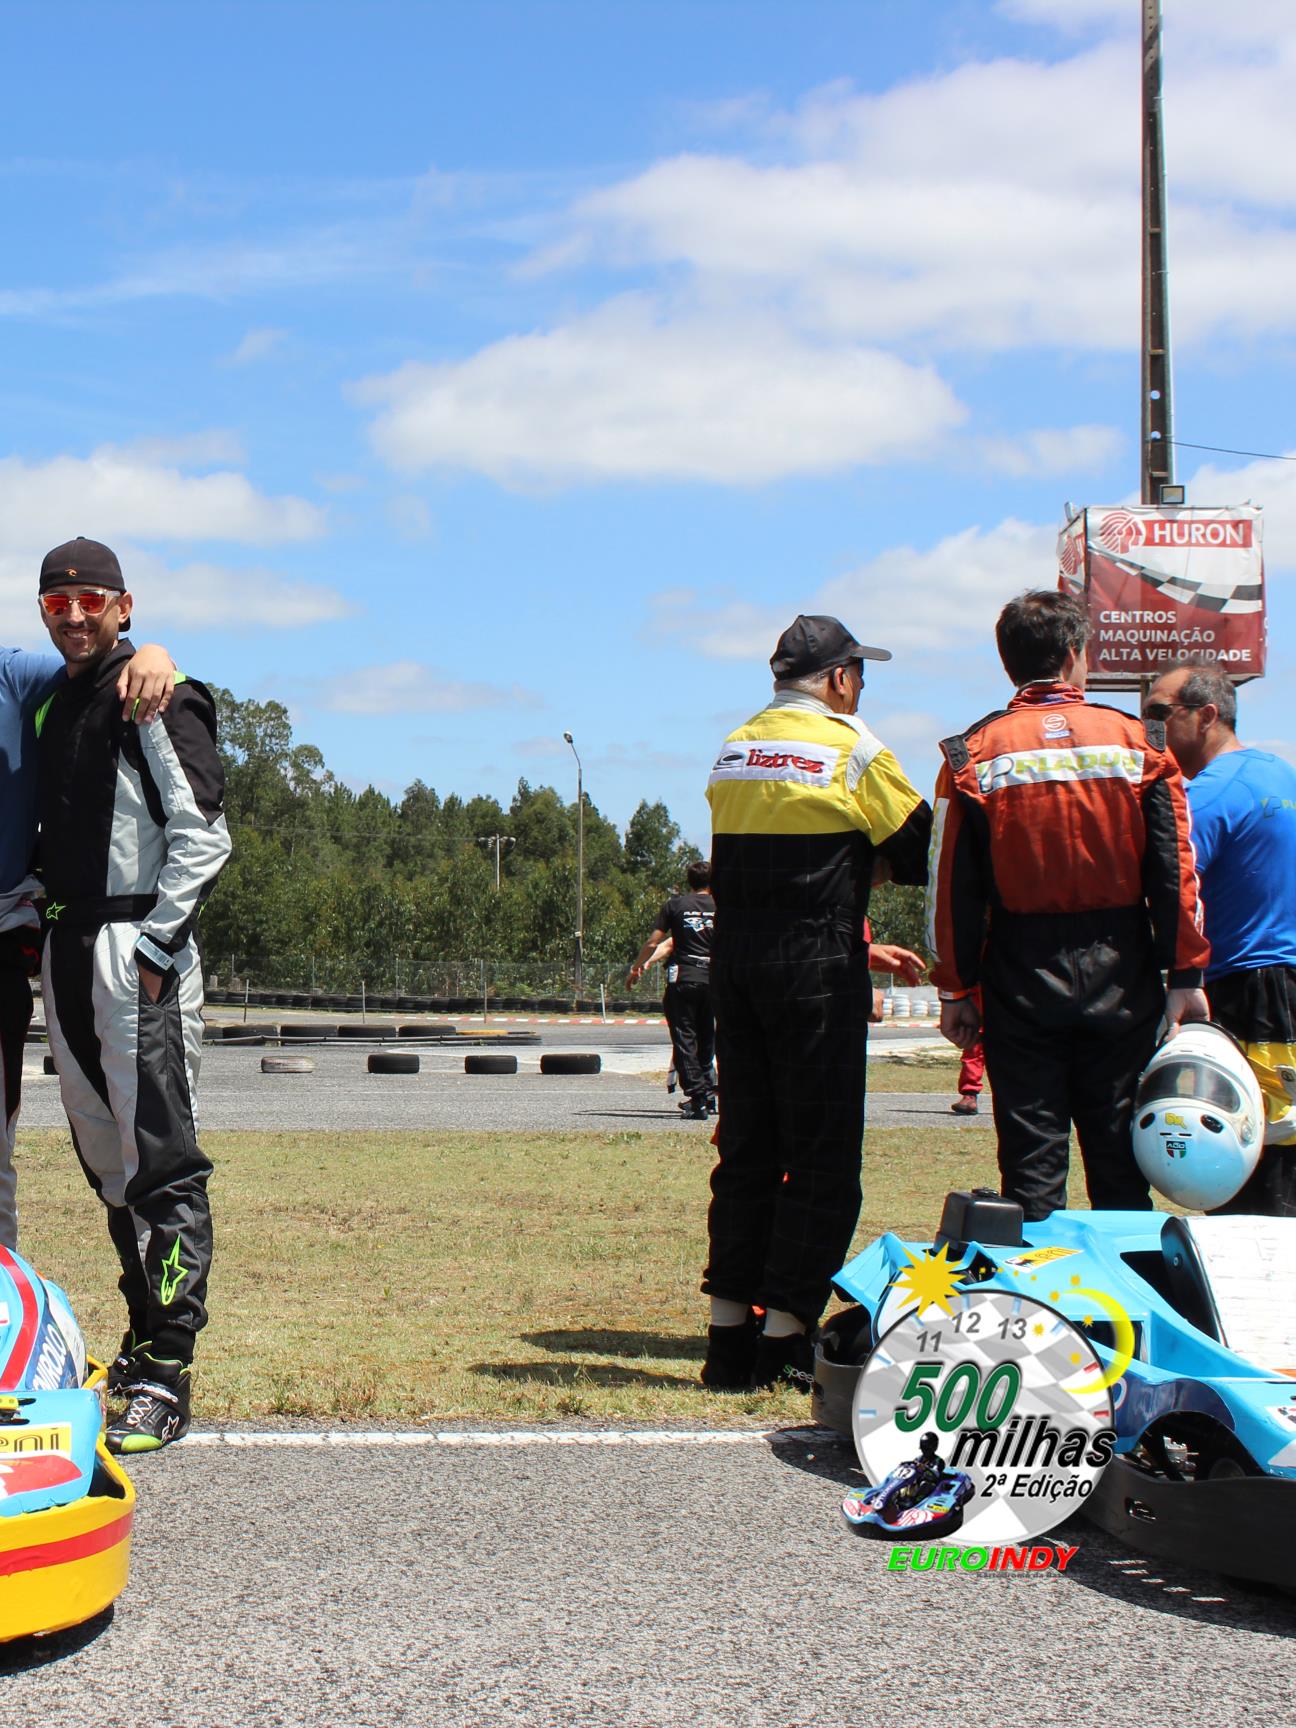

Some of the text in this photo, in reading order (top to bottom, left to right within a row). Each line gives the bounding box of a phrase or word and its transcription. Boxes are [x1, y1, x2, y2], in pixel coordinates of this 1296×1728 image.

[1153, 523, 1244, 545] HURON
[1099, 610, 1177, 624] CENTROS
[1099, 627, 1215, 646] MAQUINAÇÃO
[1099, 648, 1142, 661] ALTA
